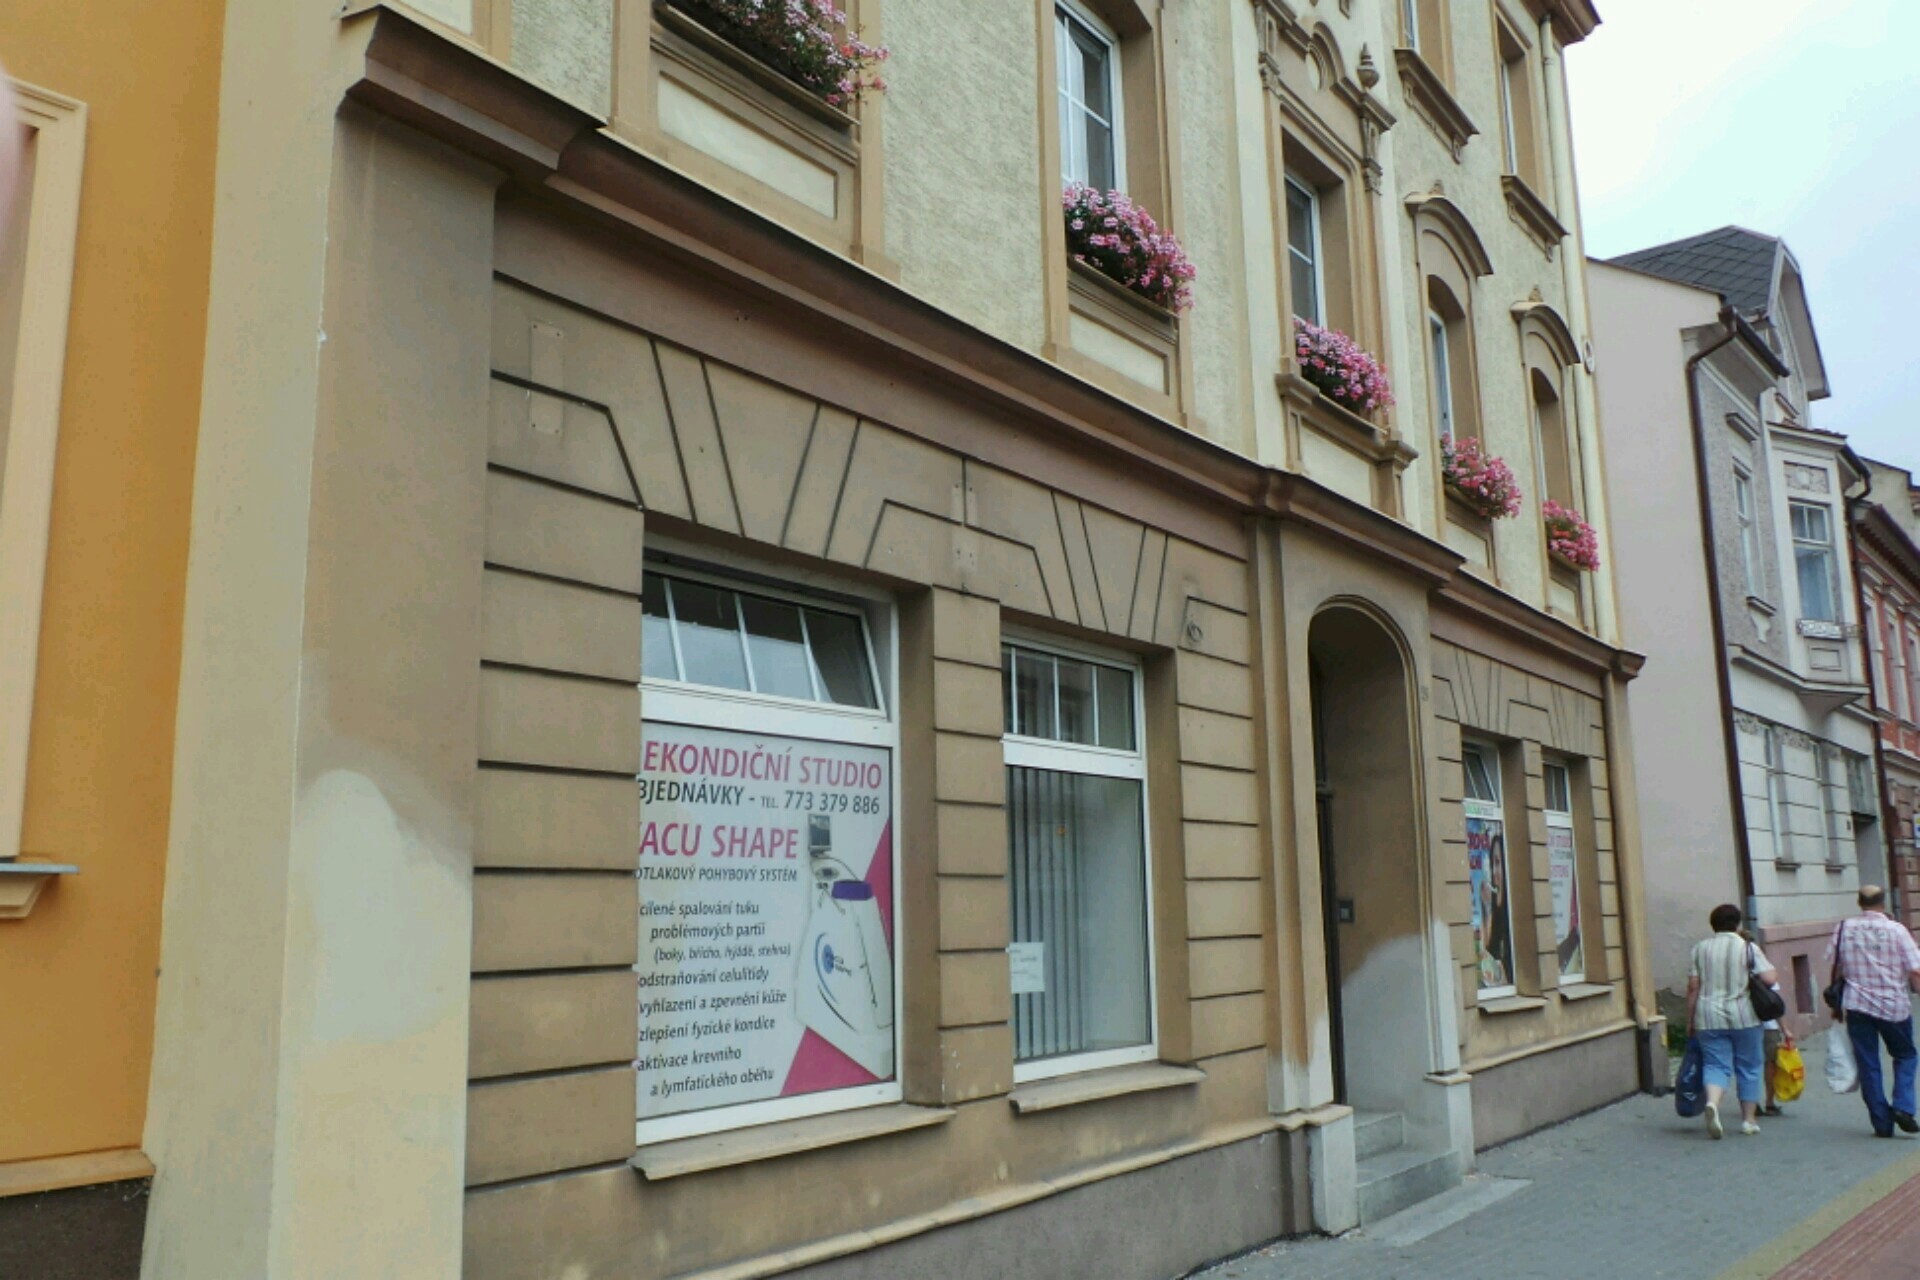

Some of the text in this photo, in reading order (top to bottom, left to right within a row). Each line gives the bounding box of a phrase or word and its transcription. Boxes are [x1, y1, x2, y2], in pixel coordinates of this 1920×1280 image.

[799, 756, 882, 789] STUDIO
[784, 790, 813, 811] 773
[819, 793, 848, 812] 379
[853, 795, 880, 815] 886
[638, 818, 799, 859] ACU SHAPE
[699, 865, 756, 881] POHYBOVÝ
[759, 866, 797, 882] SYSTÉM
[679, 901, 733, 918] spalování
[736, 901, 759, 914] tuku
[651, 921, 733, 942] problémových
[638, 965, 769, 988] odstraňování celulitidy
[639, 988, 787, 1018] vyhlazení a zpevnění kůže
[639, 1014, 775, 1044] zlepšení fyzické kondice
[637, 1047, 742, 1072] aktivace krevního
[651, 1066, 774, 1099] a lymfatického oběhu
